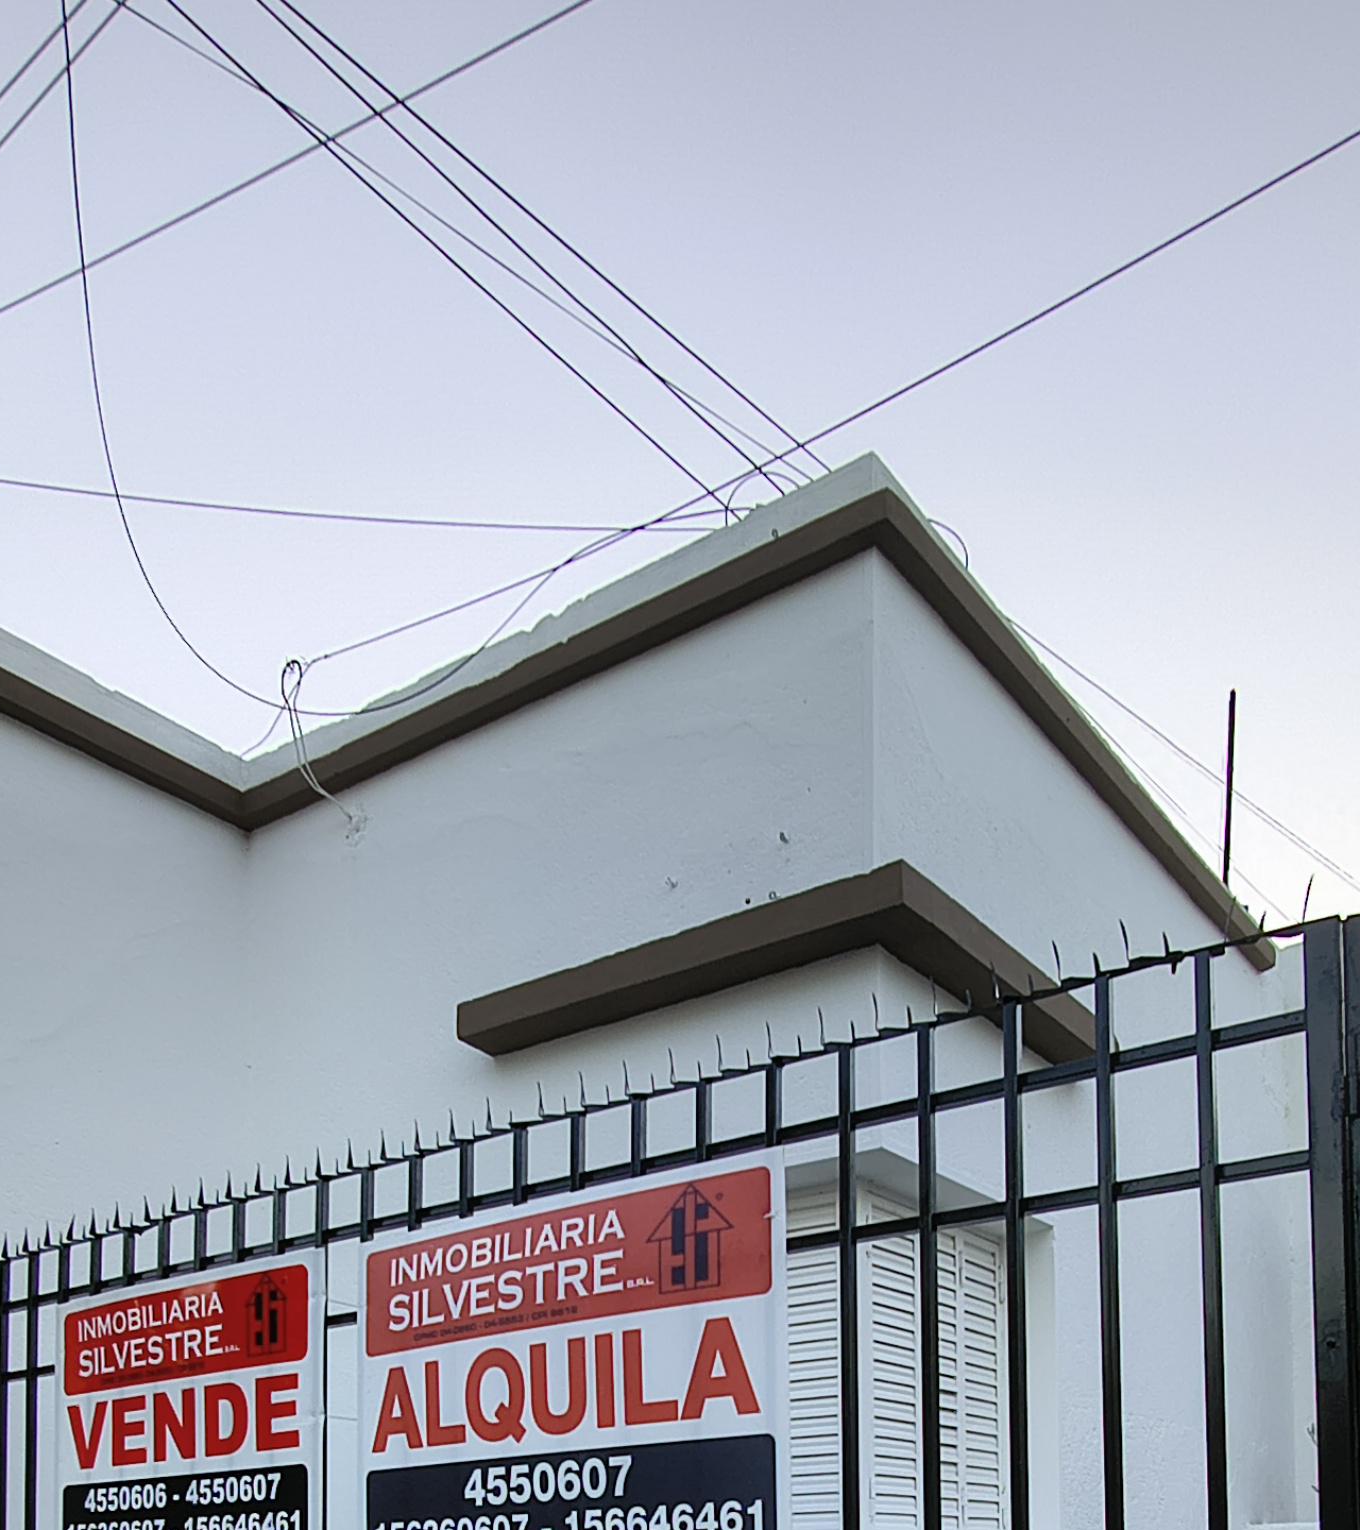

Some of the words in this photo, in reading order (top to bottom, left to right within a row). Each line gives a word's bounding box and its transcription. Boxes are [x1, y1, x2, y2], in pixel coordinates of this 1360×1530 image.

[390, 1209, 625, 1287] INMOBILIARIA
[77, 1291, 224, 1342] INMOBILIARIA
[388, 1250, 624, 1332] SILVESTRE
[78, 1324, 224, 1378] SILVESTRE
[372, 1317, 761, 1453] ALQUILA
[67, 1373, 300, 1470] VENDE
[84, 1483, 168, 1513] 4550606
[185, 1472, 282, 1505] 4550607
[464, 1455, 633, 1507] 4550607
